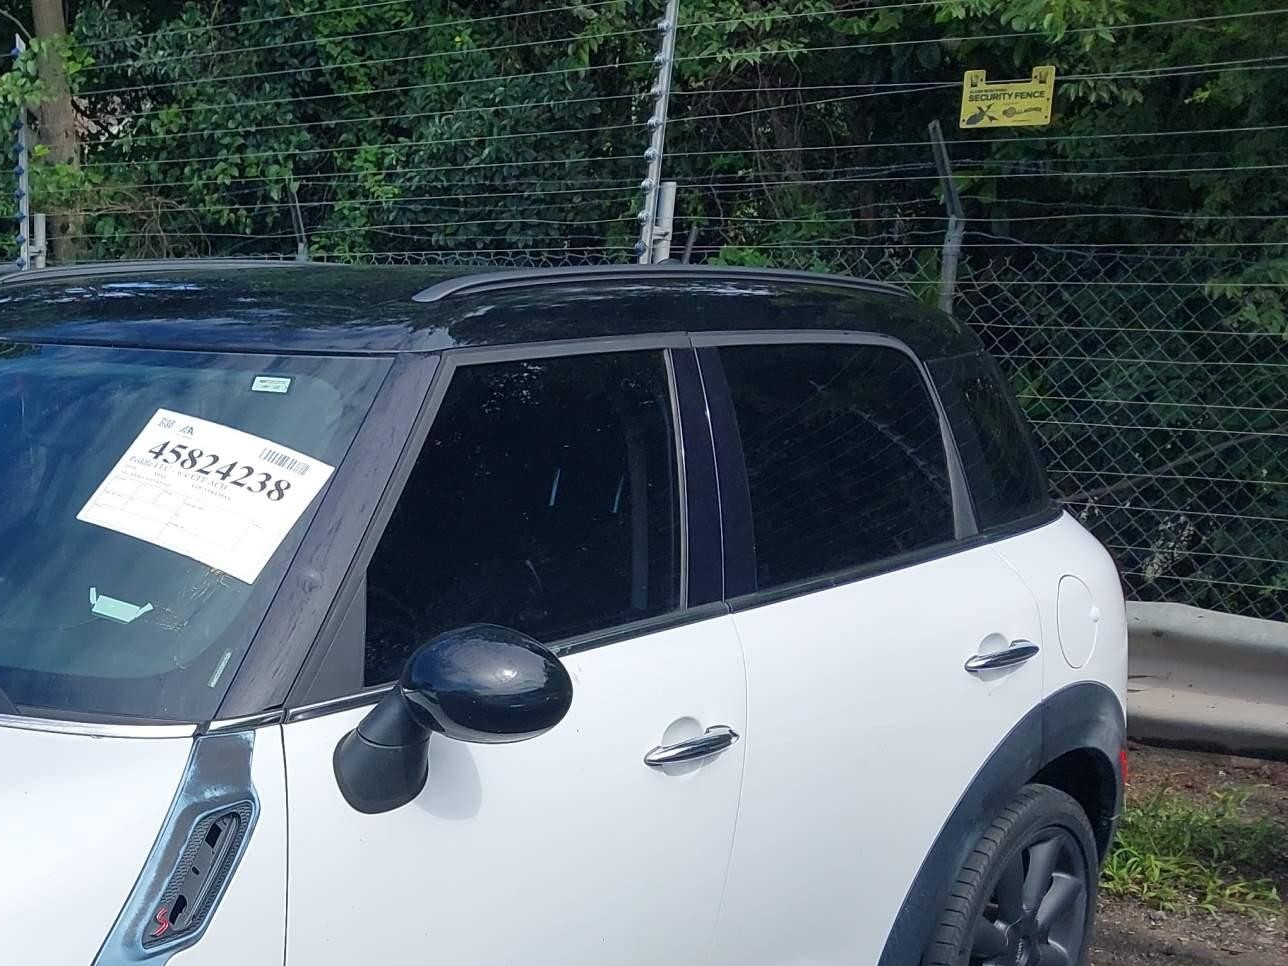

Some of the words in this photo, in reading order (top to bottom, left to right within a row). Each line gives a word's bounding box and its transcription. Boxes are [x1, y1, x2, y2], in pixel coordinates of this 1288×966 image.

[968, 92, 1013, 102] SECURITY
[1015, 90, 1046, 99] FENCE
[147, 440, 292, 502] 45824238
